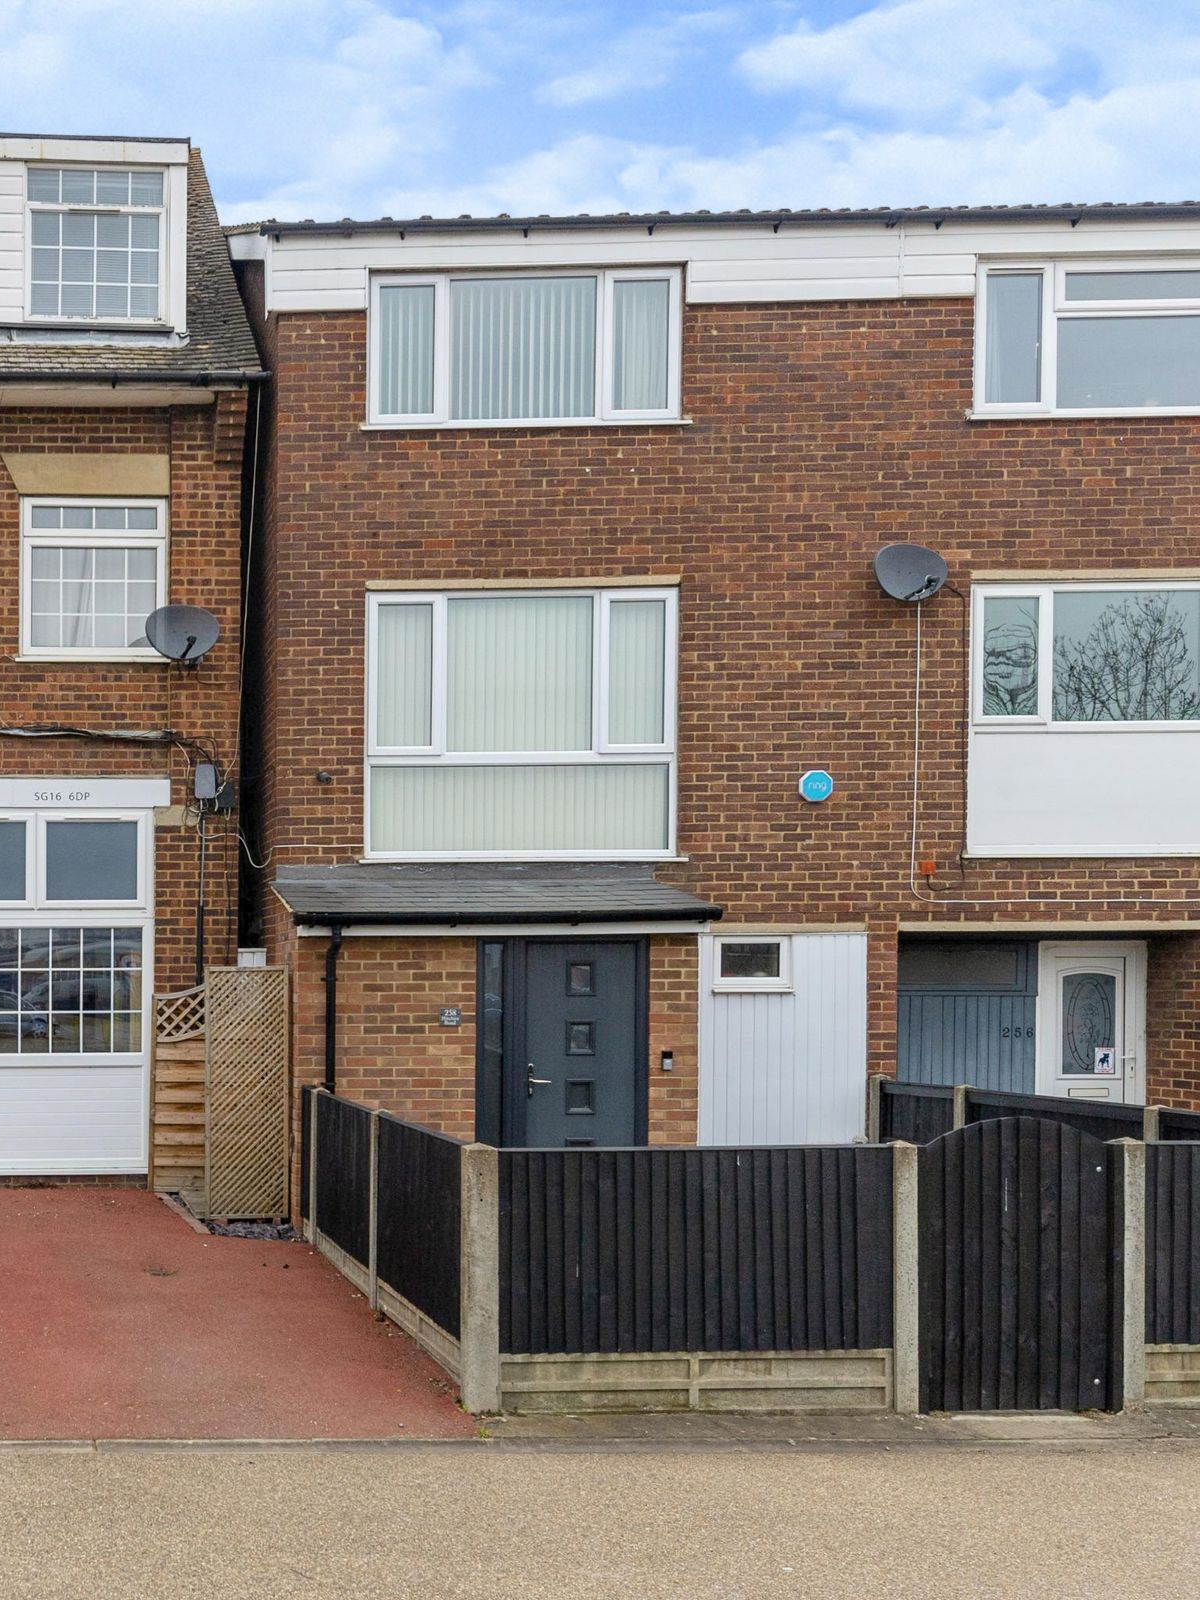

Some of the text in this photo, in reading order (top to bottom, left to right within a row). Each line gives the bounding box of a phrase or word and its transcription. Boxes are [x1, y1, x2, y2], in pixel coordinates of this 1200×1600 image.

[34, 792, 62, 801] SG16
[68, 792, 90, 801] 6DP
[1002, 1026, 1034, 1039] 256
